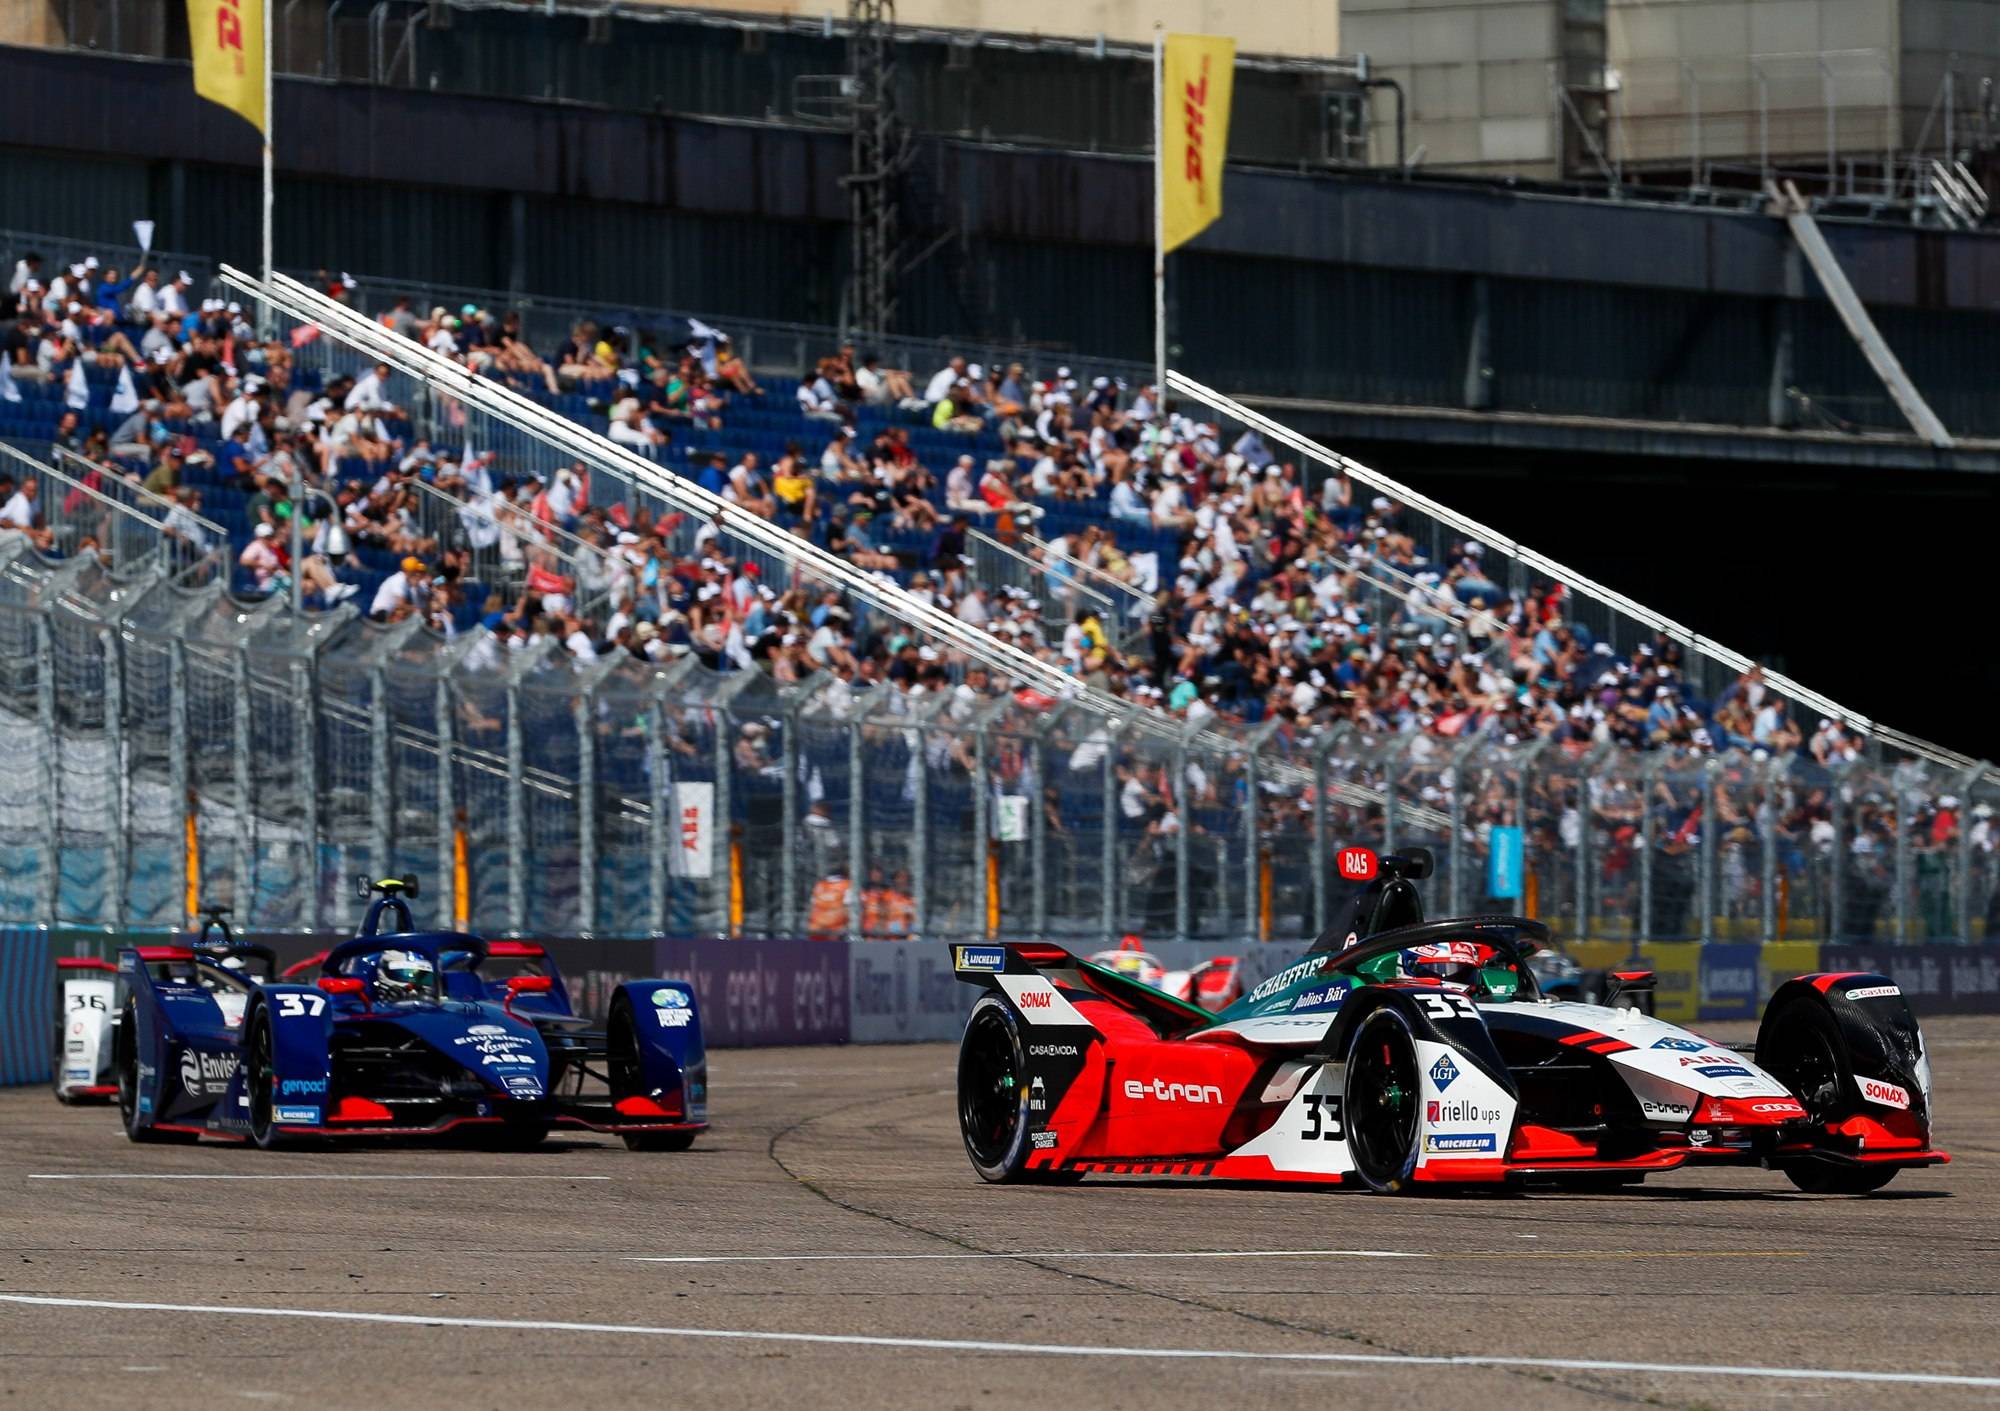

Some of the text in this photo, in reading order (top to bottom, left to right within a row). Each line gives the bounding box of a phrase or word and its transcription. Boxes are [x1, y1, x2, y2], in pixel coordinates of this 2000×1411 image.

[1184, 77, 1209, 183] DHL
[681, 805, 699, 853] ABB
[1345, 851, 1368, 875] RAS
[969, 954, 1001, 965] MICHELIN
[1020, 992, 1052, 1009] SONAX
[1291, 992, 1324, 1012] Julius
[1324, 986, 1347, 1003] Bär
[1860, 987, 1897, 996] Castrol
[69, 994, 106, 1013] 36
[275, 993, 326, 1017] 37
[1413, 993, 1483, 1021] 33
[200, 1052, 241, 1080] Envisi
[1680, 1055, 1741, 1067] ABB
[1433, 1067, 1455, 1080] LGT
[281, 1078, 327, 1096] genpact
[1124, 1077, 1223, 1105] e-tron
[1865, 1082, 1905, 1104] SONAX
[1301, 1095, 1346, 1141] 33
[1442, 1100, 1501, 1124] riello ups
[1644, 1102, 1690, 1114] e-tron
[1438, 1139, 1490, 1149] MICHELIN
